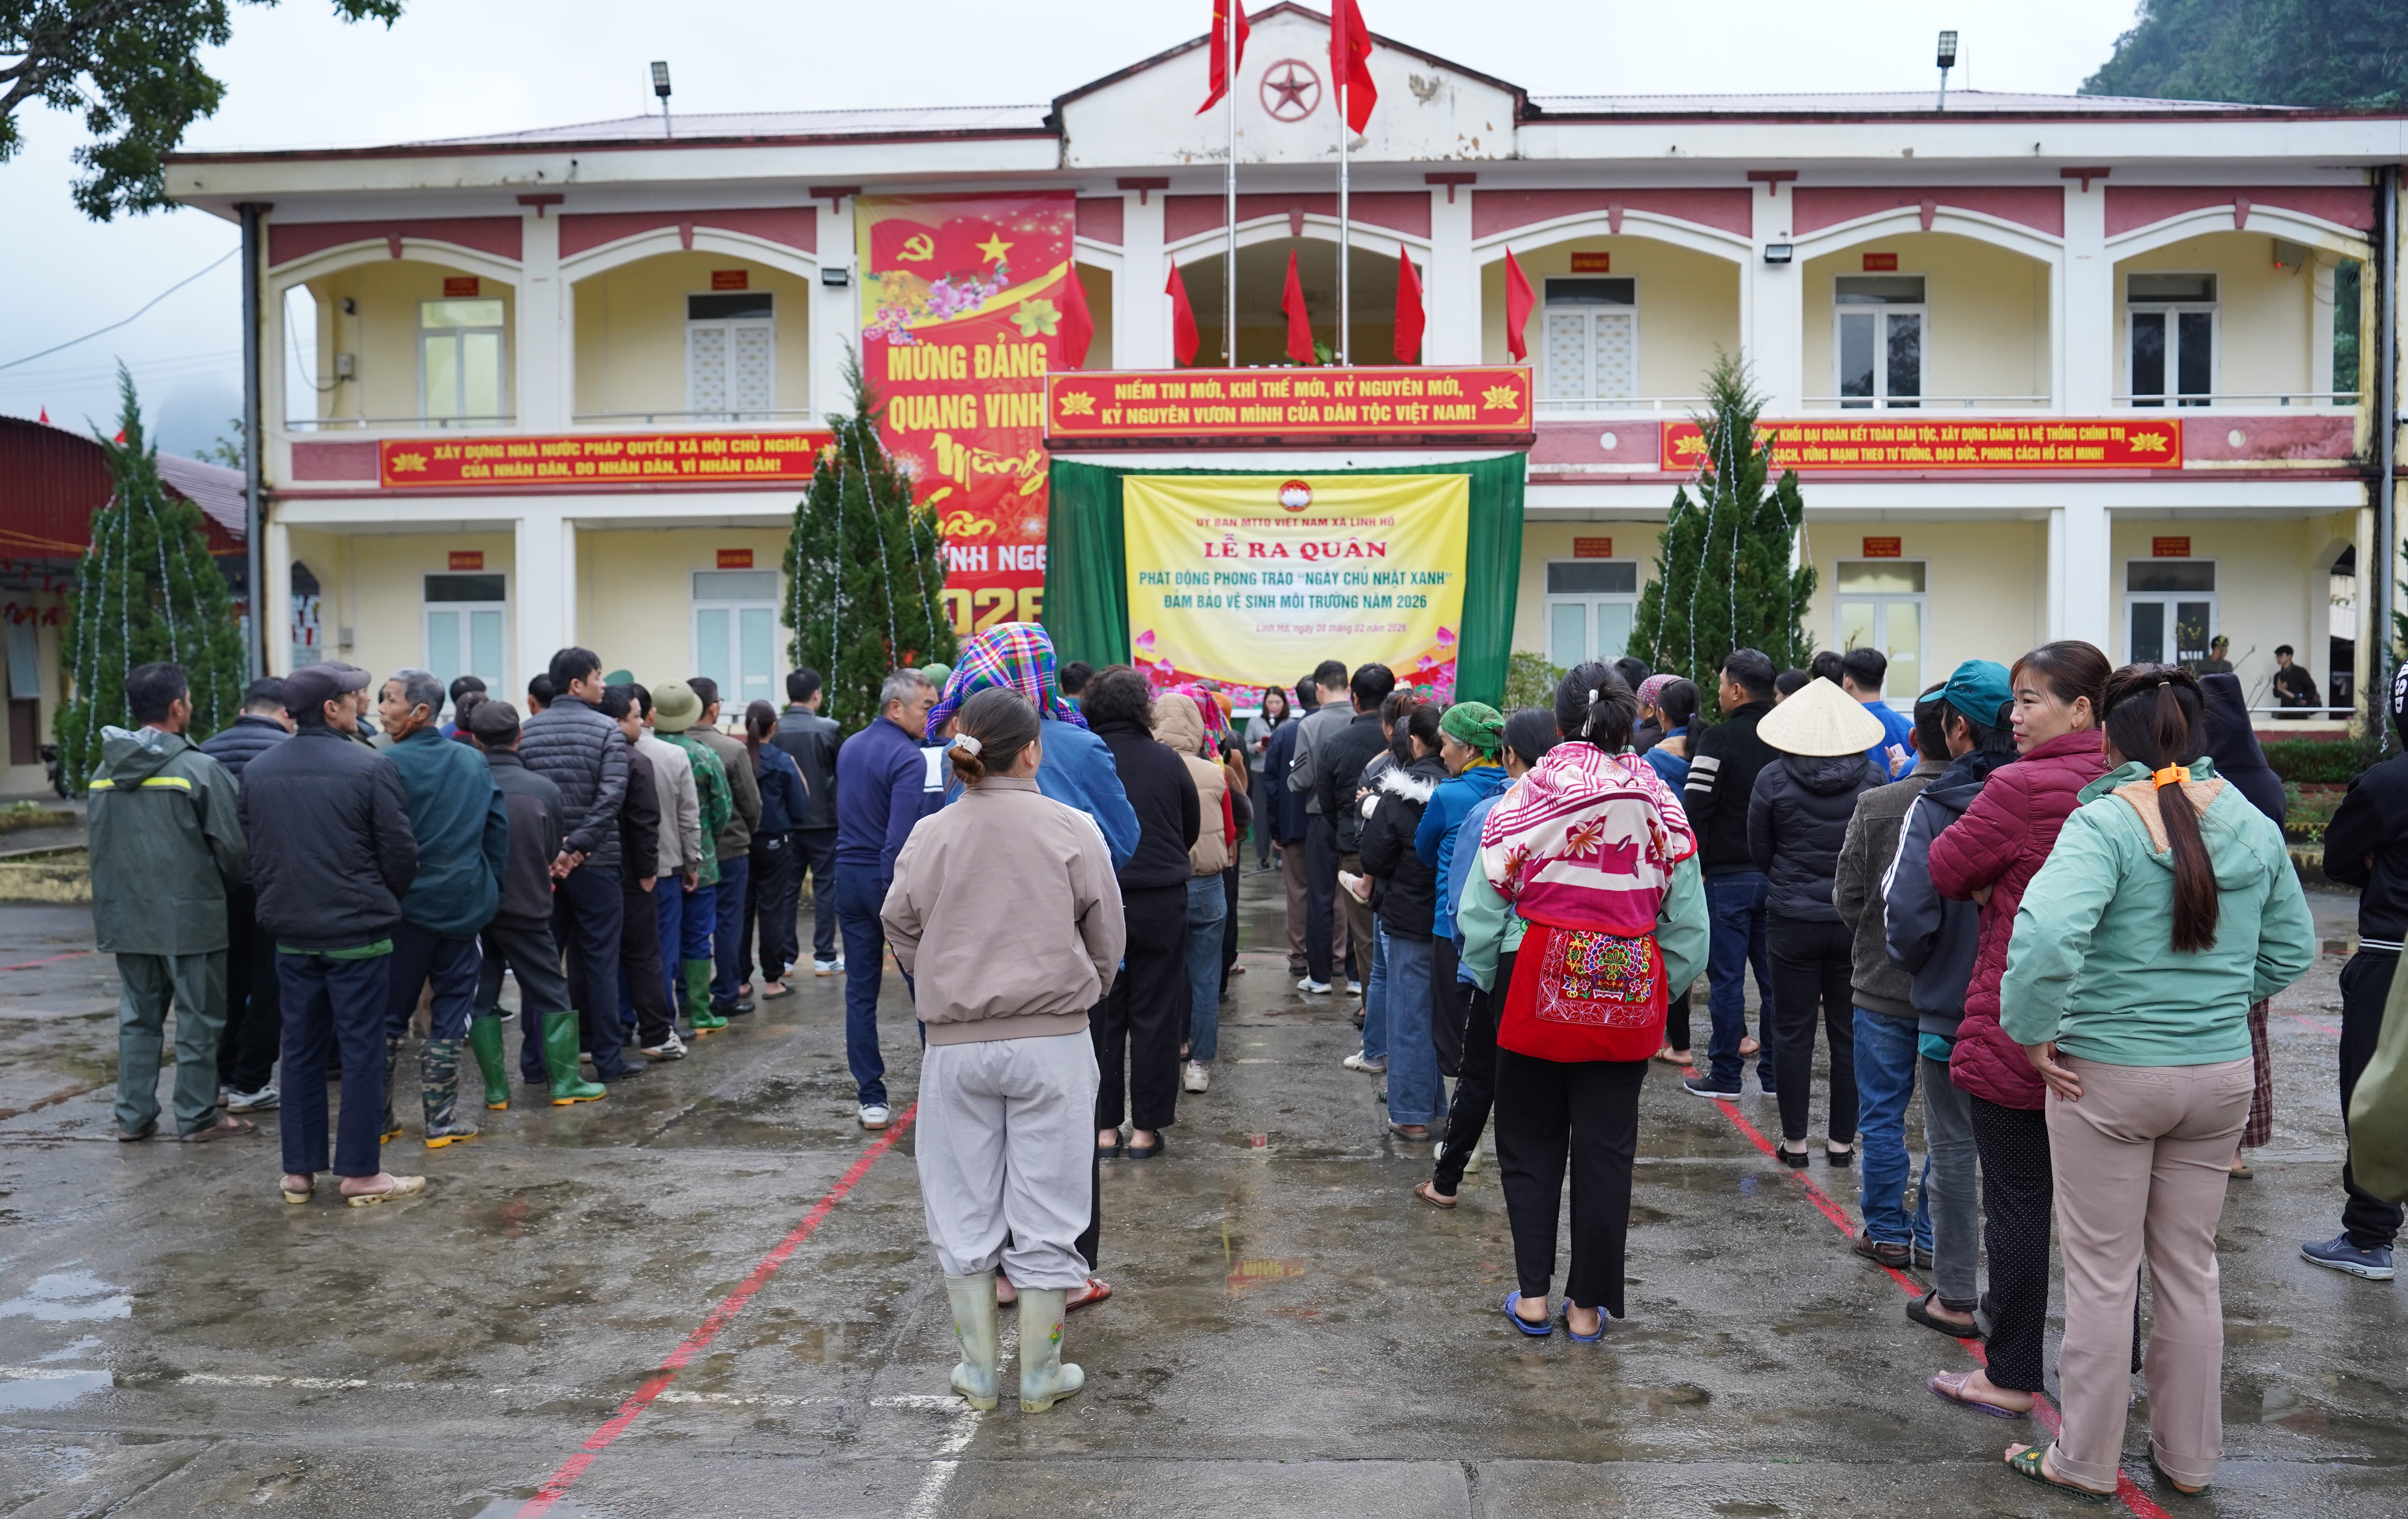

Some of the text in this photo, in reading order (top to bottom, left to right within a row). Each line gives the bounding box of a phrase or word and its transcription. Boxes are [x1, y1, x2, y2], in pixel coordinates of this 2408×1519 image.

[888, 332, 1047, 381] MỪNG ĐẢNG
[1115, 376, 1463, 400] NIỀM TIN MỚI, KHÍ THẾ MỚI, KỶ NGUYÊN MỚI,
[889, 392, 1045, 435] QUANG VINH
[1102, 402, 1476, 424] KỶ NGUYÊN VƯƠN MÌNH CỦA DÂN TỘC VIỆT NAM!
[1780, 425, 1802, 441] KHỐI
[1804, 429, 1820, 443] ĐẠI
[1822, 427, 1848, 441] ĐOÀN
[1850, 425, 1868, 441] KẾT
[1869, 425, 1894, 441] TOÀN
[1896, 426, 1916, 441] DÂN
[1918, 426, 1939, 442] TỘC,
[1941, 426, 1959, 440] XÂY
[1962, 427, 1987, 442] DỰNG
[1989, 423, 2015, 440] ĐẢNG
[2018, 427, 2030, 440] VÀ
[2032, 426, 2044, 442] HỆ
[2046, 424, 2077, 440] THỐNG
[2079, 427, 2108, 440] CHÍNH
[2110, 428, 2125, 441] TRỊ
[434, 444, 461, 459] XÂY
[465, 444, 504, 459] DỰNG
[507, 442, 538, 458] NHÀ
[541, 441, 581, 457] NƯỚC
[584, 440, 623, 455] PHÁP
[679, 438, 698, 453] XÃ
[702, 438, 727, 455] HỘI
[730, 437, 761, 453] CHỦ
[1773, 449, 1801, 464] SẠCH,
[1802, 445, 1828, 461] VỮNG
[1830, 448, 1859, 463] MẠNH
[1860, 448, 1884, 460] THEO
[1886, 447, 1899, 460] TƯ
[1900, 444, 1934, 460] TƯỞNG,
[1936, 448, 1955, 462] ĐẠO
[1957, 445, 1979, 460] ĐỨC,
[1981, 447, 2013, 460] PHONG
[2015, 447, 2040, 460] CÁCH
[2042, 445, 2055, 460] HỒ
[2057, 447, 2073, 460] CHÍ
[2076, 447, 2104, 459] MINH!
[461, 457, 781, 478] CỦA NHÂN DÂN, DO NHÂN DÂN, VÌ NHÂN DÂN!
[929, 432, 1049, 497] Mừng
[1215, 518, 1237, 527] BAN
[1242, 518, 1271, 527] MTTQ
[1275, 517, 1298, 527] VIỆT
[1350, 518, 1375, 526] LINH
[1205, 534, 1386, 561] LỄ RA QUÂN
[1140, 569, 1170, 584] PHÁT
[1176, 569, 1209, 586] ĐỘNG
[1214, 572, 1257, 585] PHONG
[1262, 569, 1293, 585] TRÀO
[1344, 567, 1368, 585] CHỦ
[1373, 570, 1405, 587] NHẬT
[1164, 590, 1426, 612] ĐẢM BẢO VỆ SINH MÔI TRƯỜNG NĂM 2026
